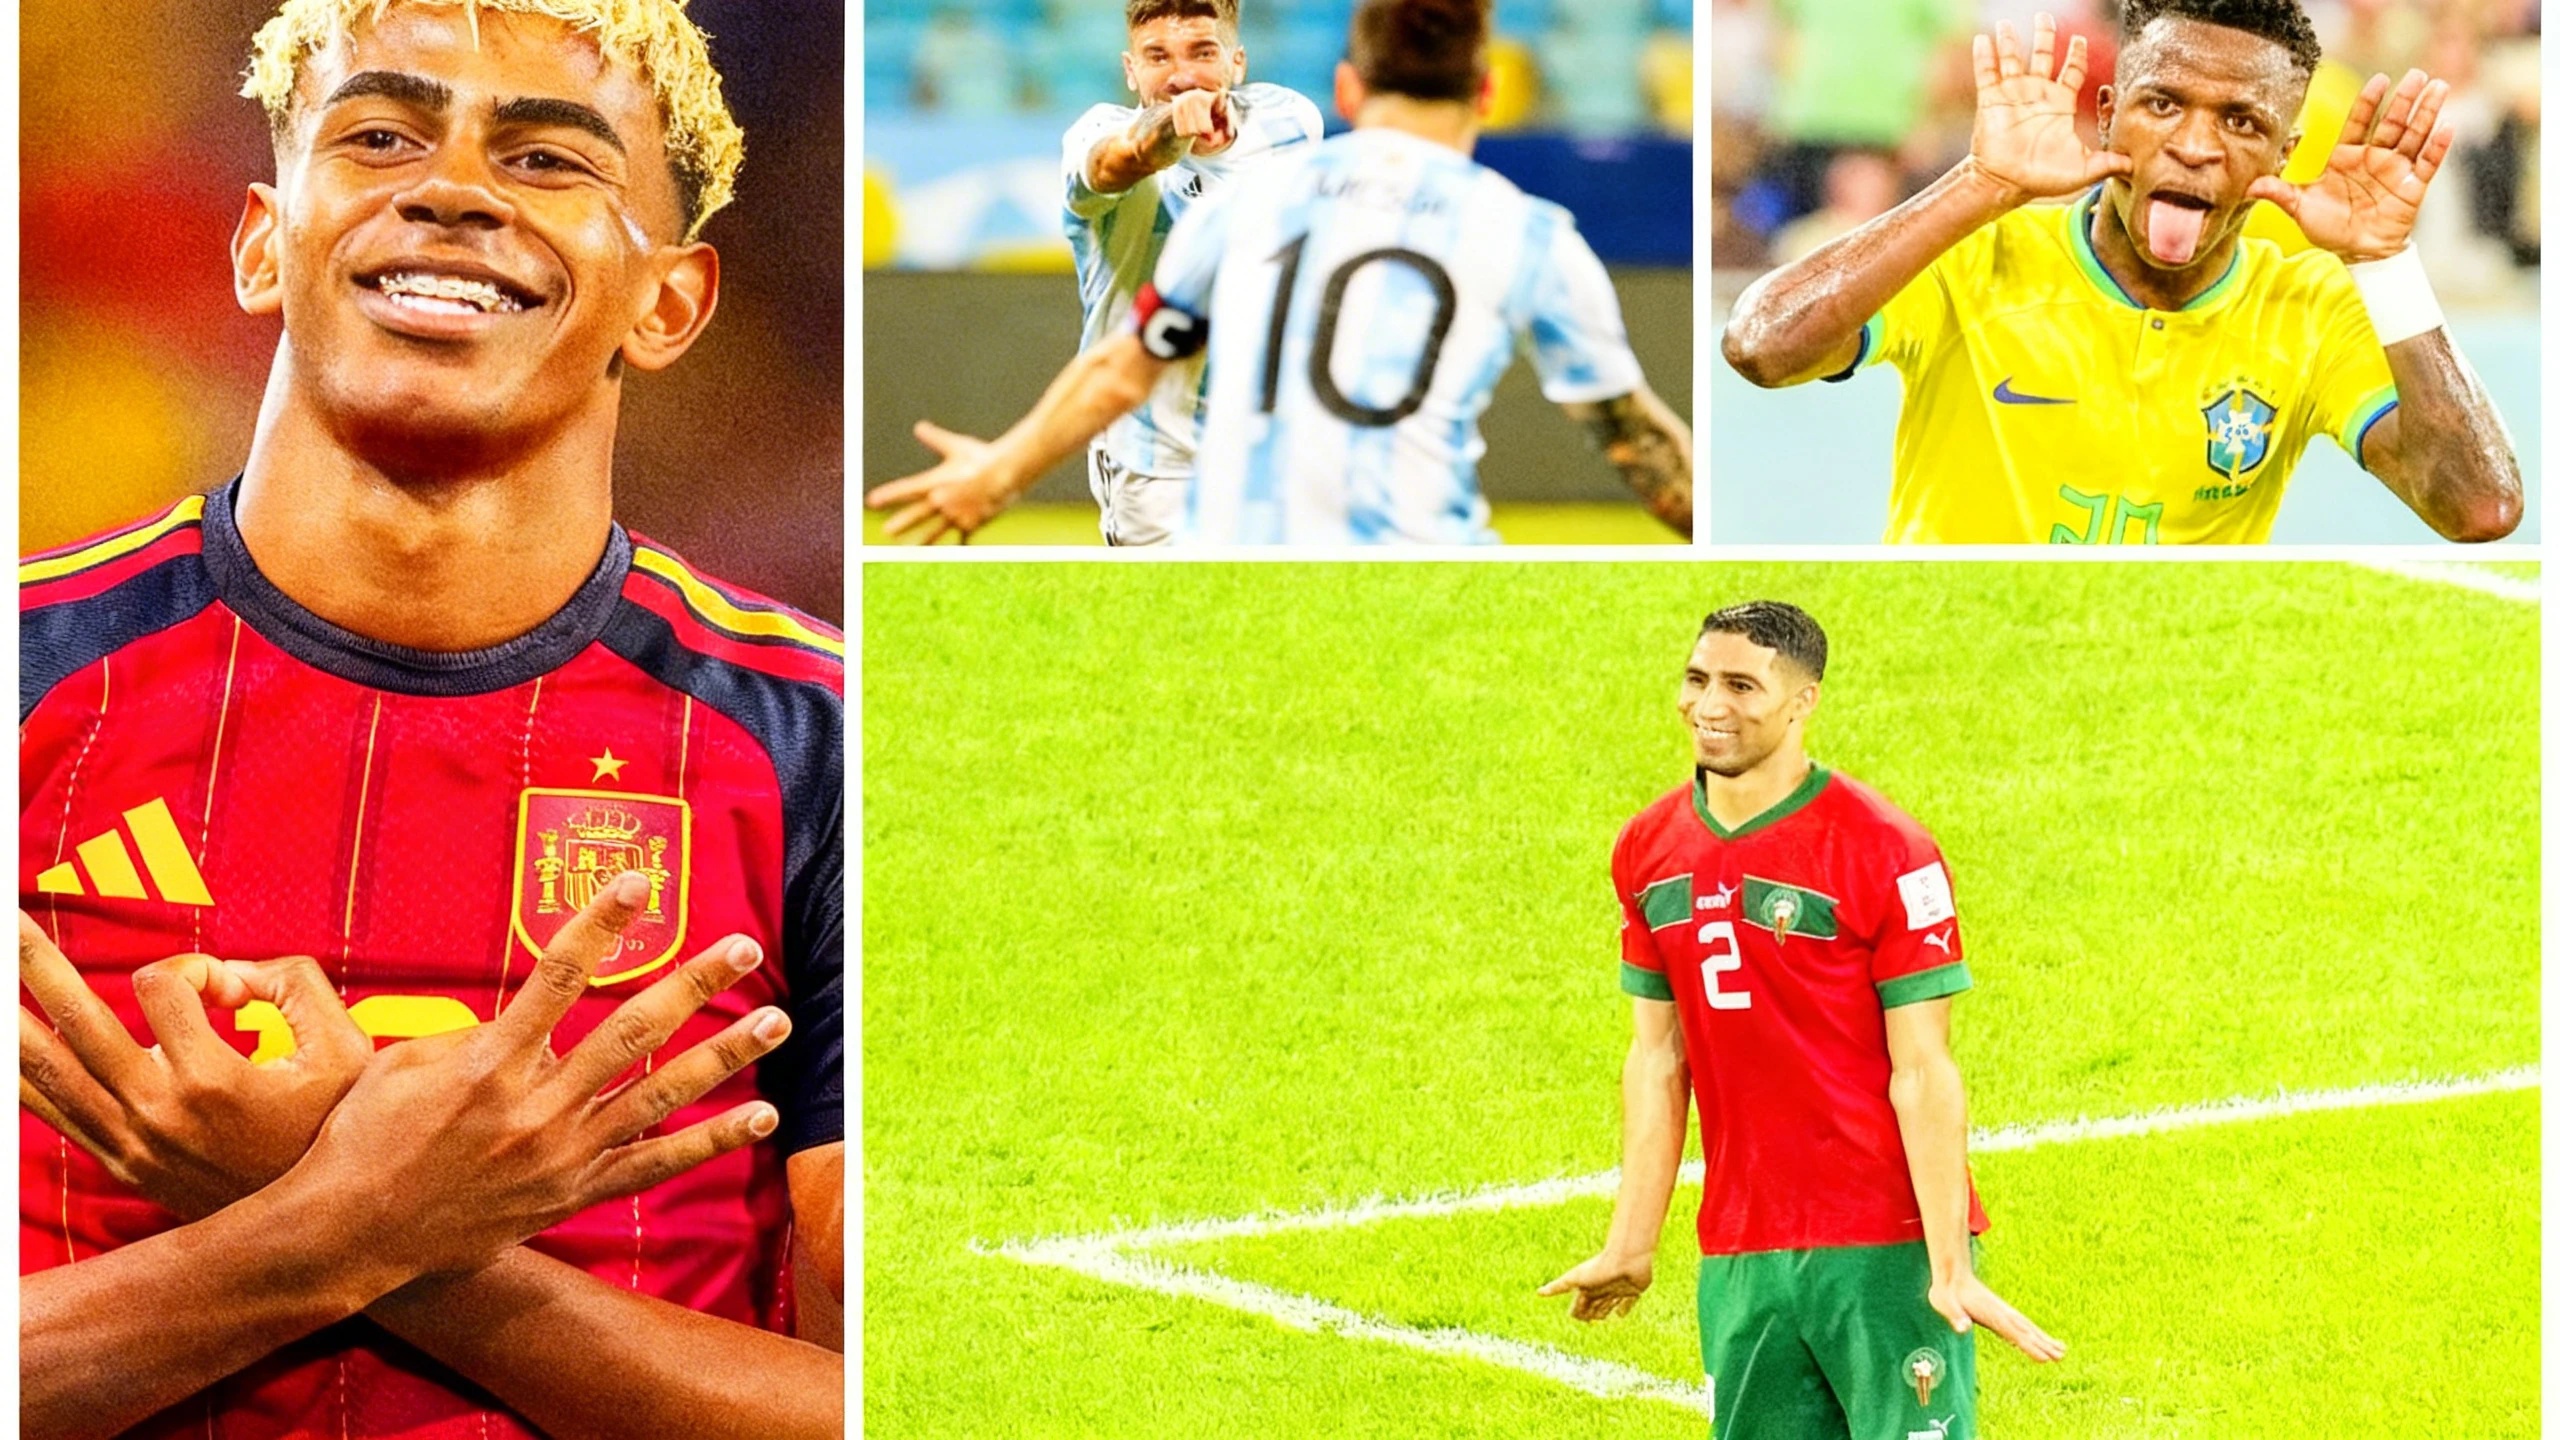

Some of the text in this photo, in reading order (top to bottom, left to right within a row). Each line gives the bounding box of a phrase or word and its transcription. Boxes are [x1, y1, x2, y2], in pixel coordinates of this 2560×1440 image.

[1142, 307, 1192, 359] C
[1260, 231, 1457, 427] 10
[1698, 921, 1752, 1010] 2
